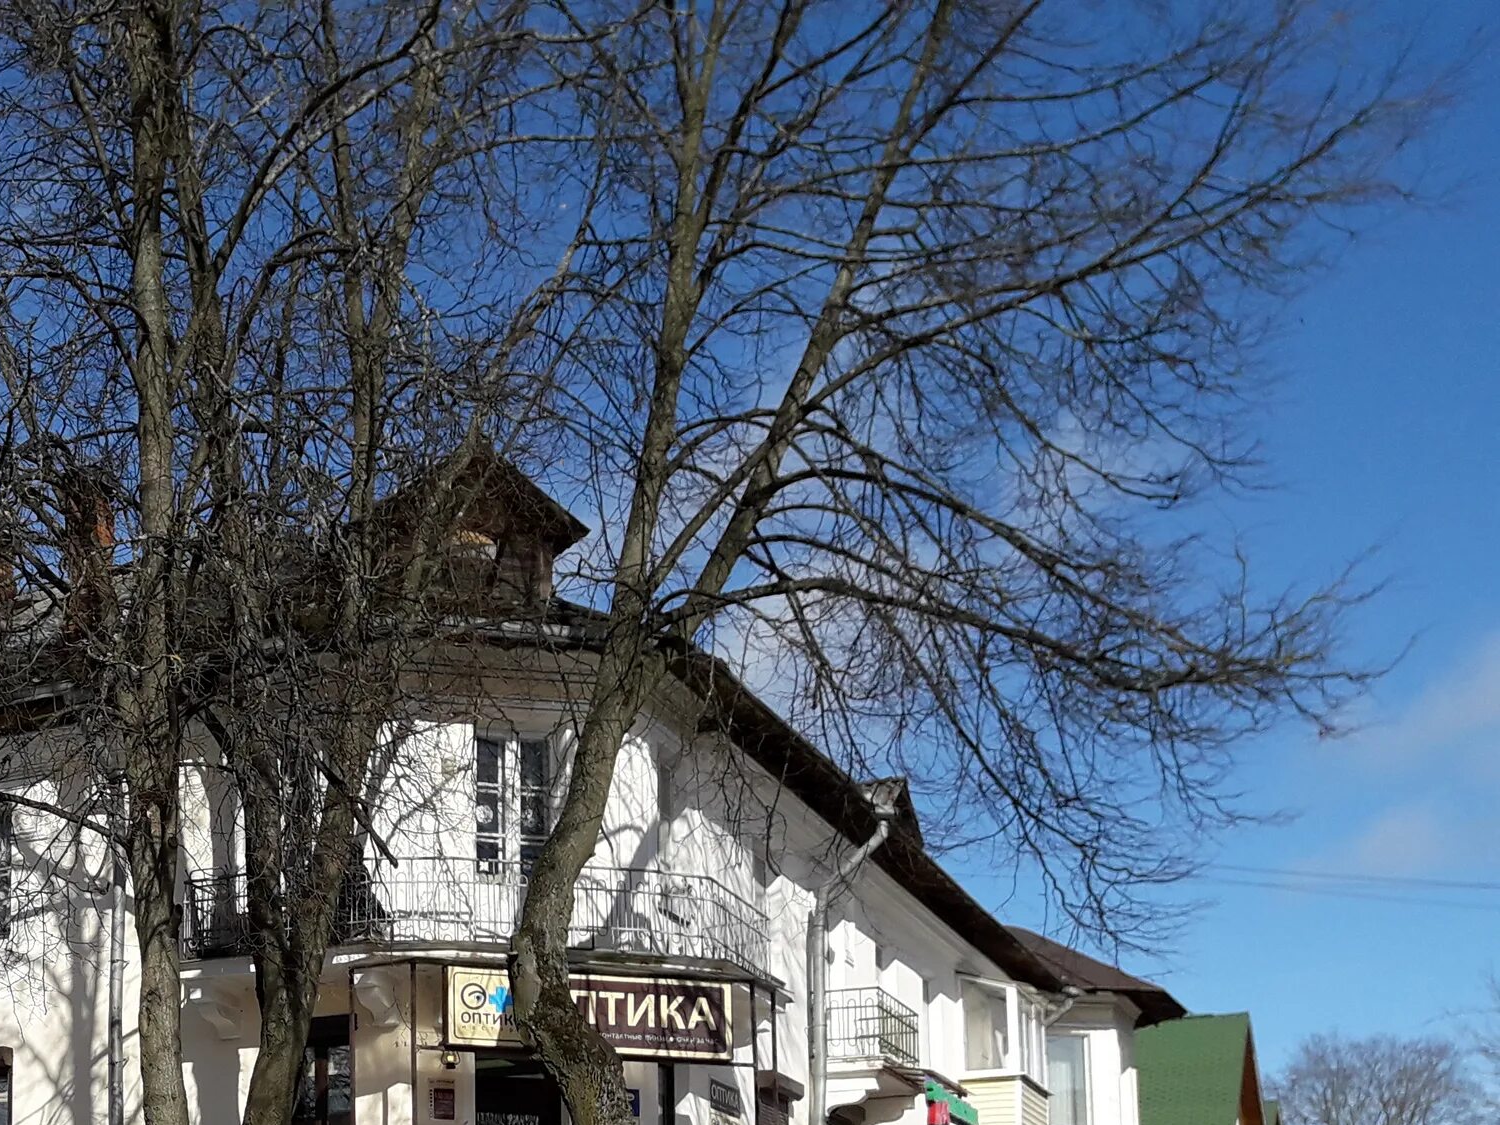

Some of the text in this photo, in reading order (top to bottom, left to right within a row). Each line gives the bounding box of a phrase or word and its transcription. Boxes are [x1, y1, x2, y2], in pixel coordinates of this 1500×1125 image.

[570, 989, 717, 1031] ПТИКА
[461, 1011, 514, 1026] ОПТИК
[600, 1032, 643, 1041] онтактные
